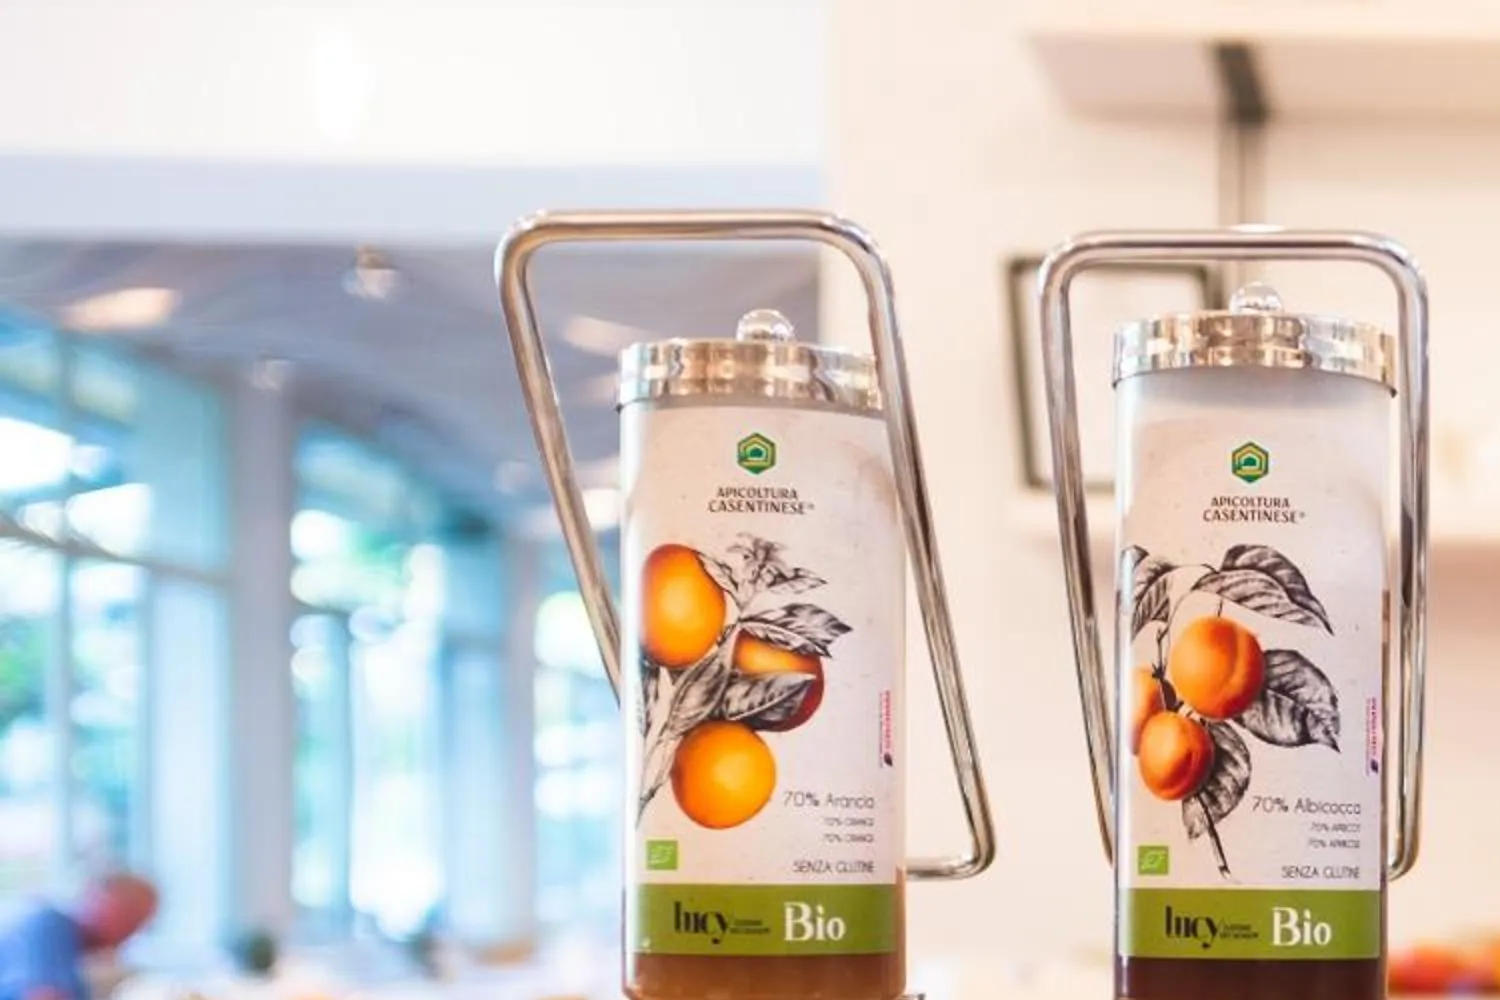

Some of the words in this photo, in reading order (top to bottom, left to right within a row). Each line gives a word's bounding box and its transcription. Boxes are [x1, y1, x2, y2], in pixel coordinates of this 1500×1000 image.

[717, 487, 799, 499] APICOLTURA
[1211, 496, 1290, 508] APICOLTURA
[783, 791, 820, 807] 70%
[1252, 796, 1289, 813] 70%
[792, 860, 832, 873] SENZA
[1281, 865, 1319, 879] SENZA
[783, 901, 846, 942] Bio
[1271, 906, 1332, 947] Bio
